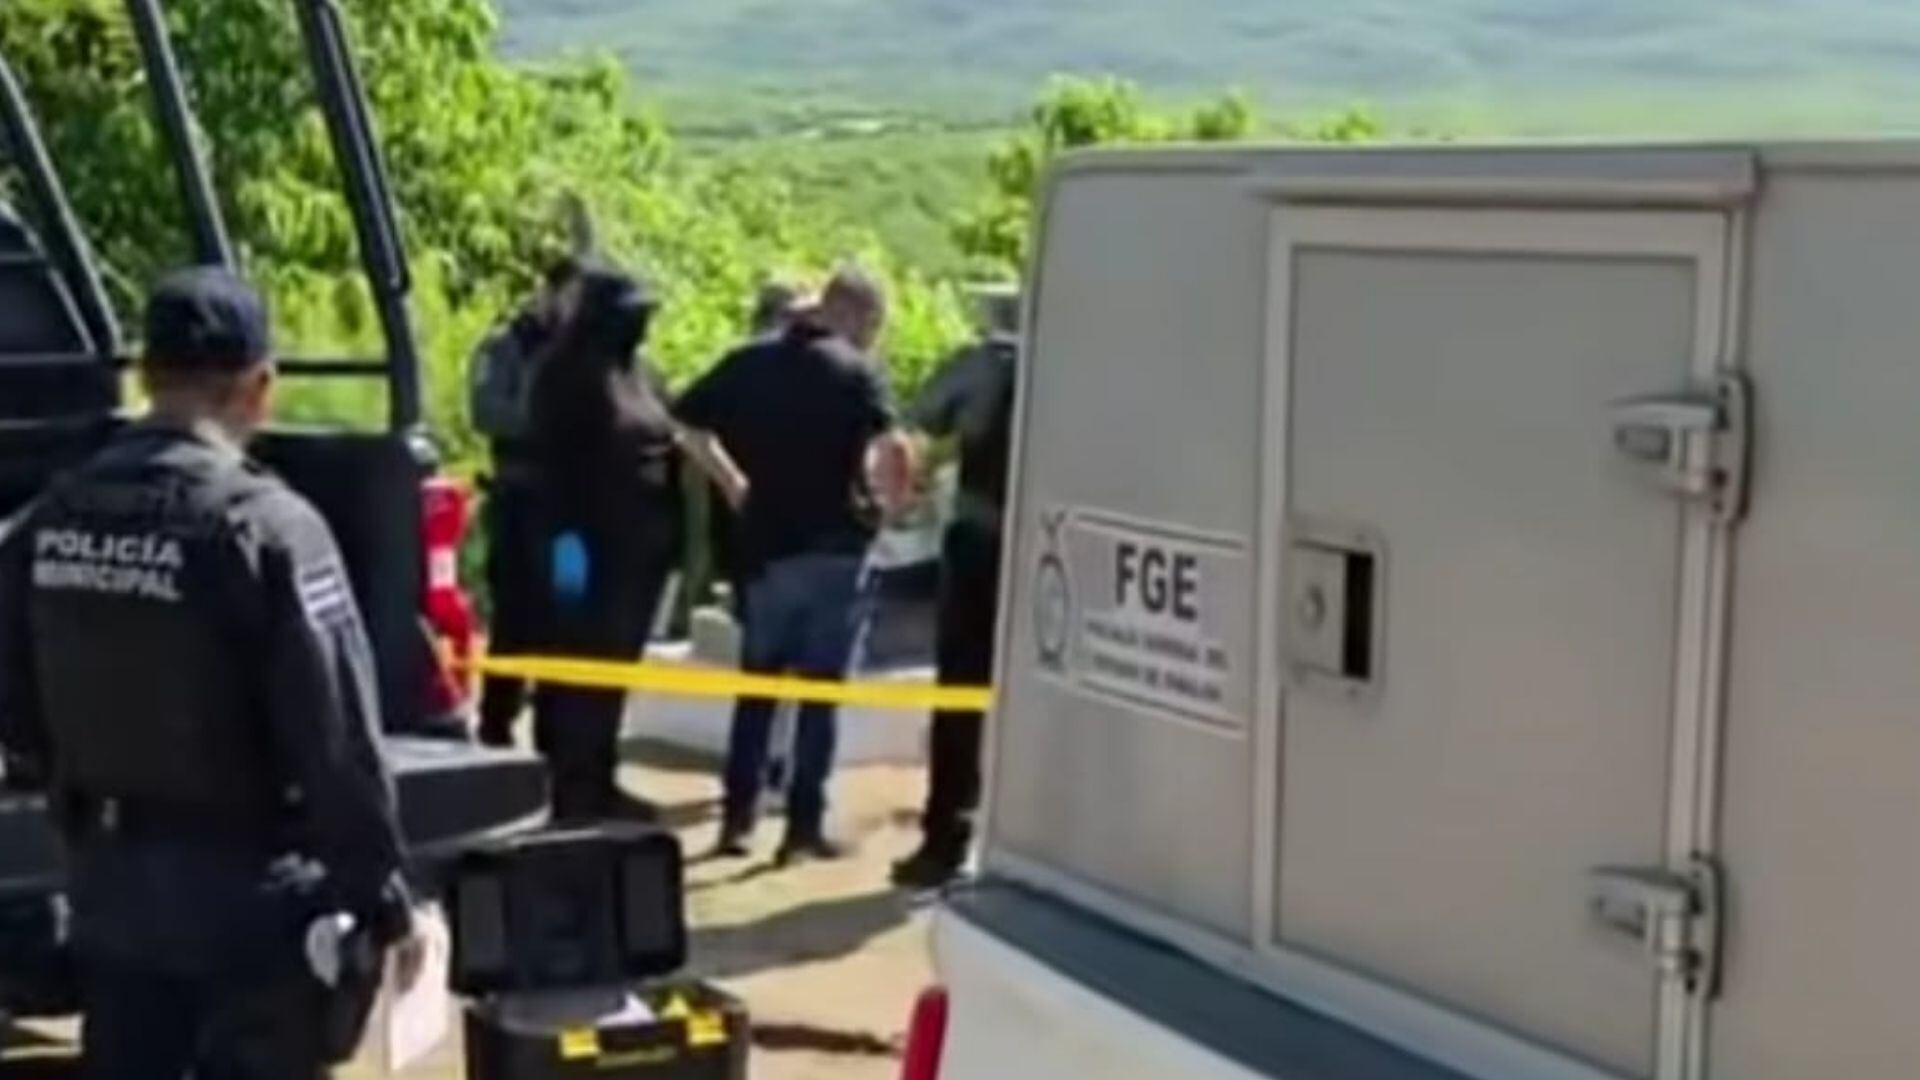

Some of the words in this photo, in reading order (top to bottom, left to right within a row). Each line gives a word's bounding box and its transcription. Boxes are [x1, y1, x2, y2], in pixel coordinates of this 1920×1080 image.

[35, 529, 182, 569] POLICÍA
[32, 559, 182, 602] MUNICIPAL
[1115, 541, 1198, 622] FGE
